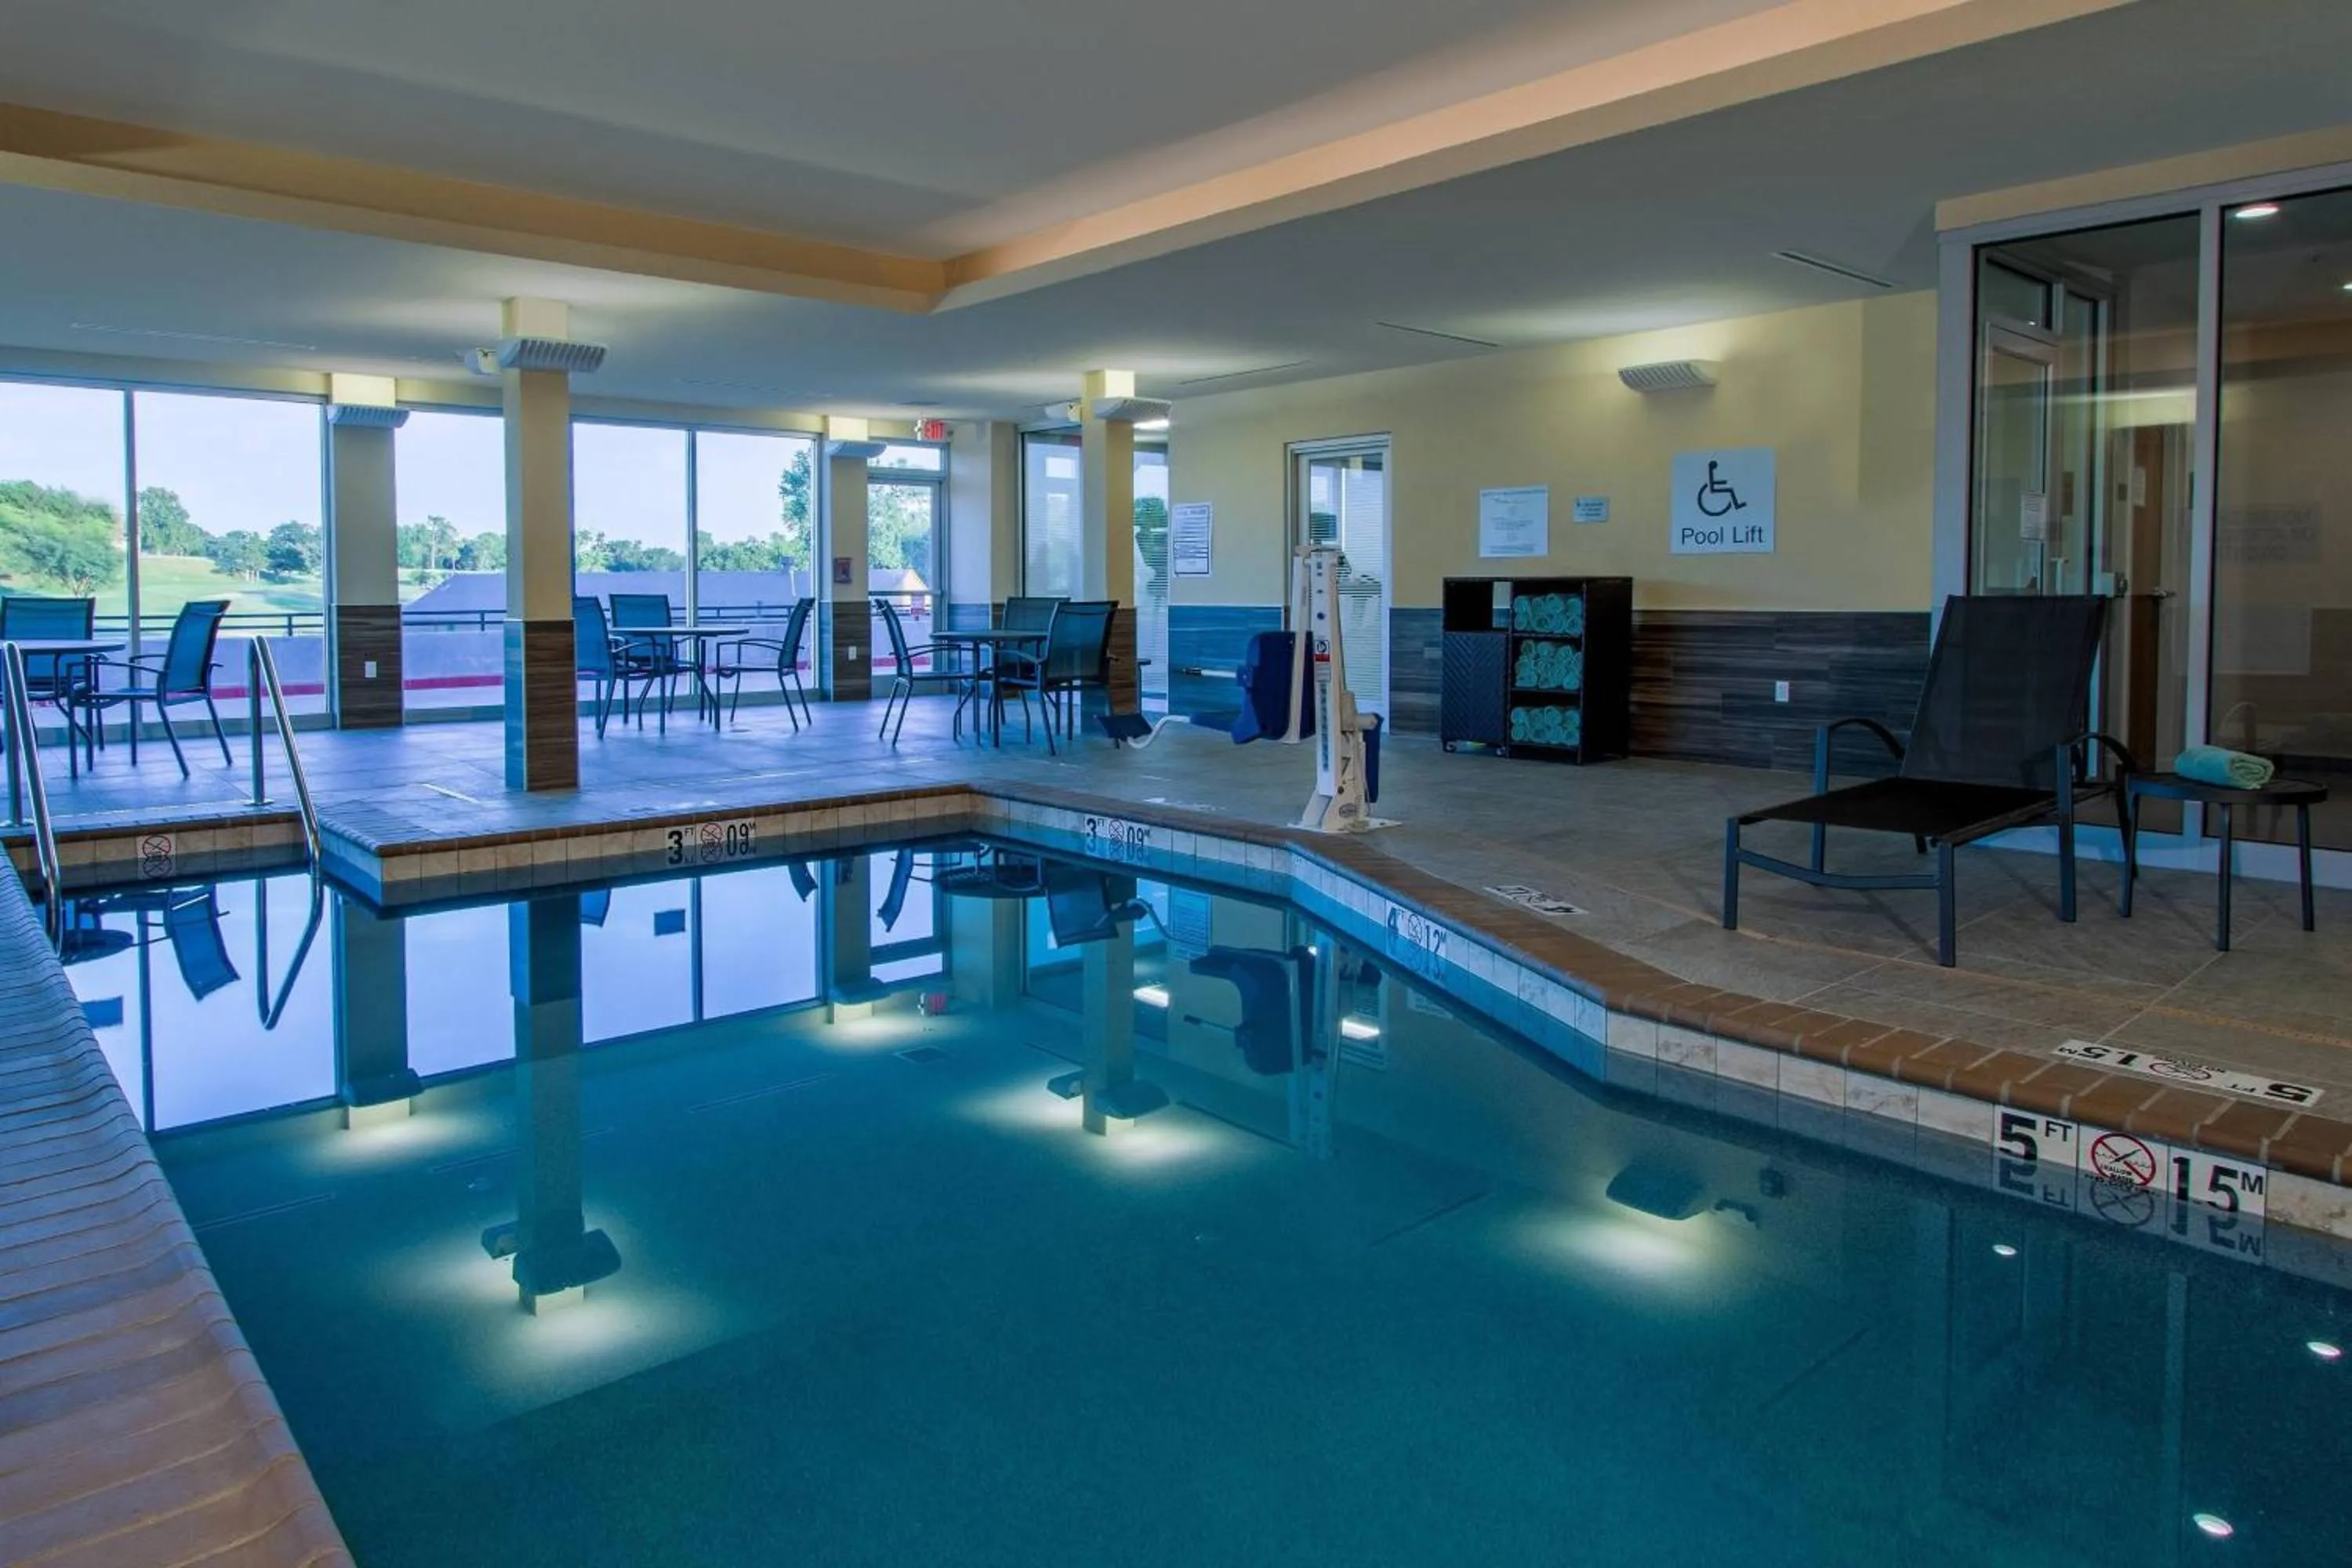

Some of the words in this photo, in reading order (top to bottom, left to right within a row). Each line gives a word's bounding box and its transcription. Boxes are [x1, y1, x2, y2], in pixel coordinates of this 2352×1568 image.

[924, 421, 945, 440] EXIT
[1681, 527, 1724, 546] Pool
[1733, 525, 1763, 544] Lift
[1086, 818, 1097, 838] 3
[668, 829, 683, 850] 3
[2226, 1083, 2256, 1093] FT
[2264, 1083, 2313, 1103] 5
[1998, 1112, 2037, 1161] 5
[2045, 1120, 2072, 1143] FT
